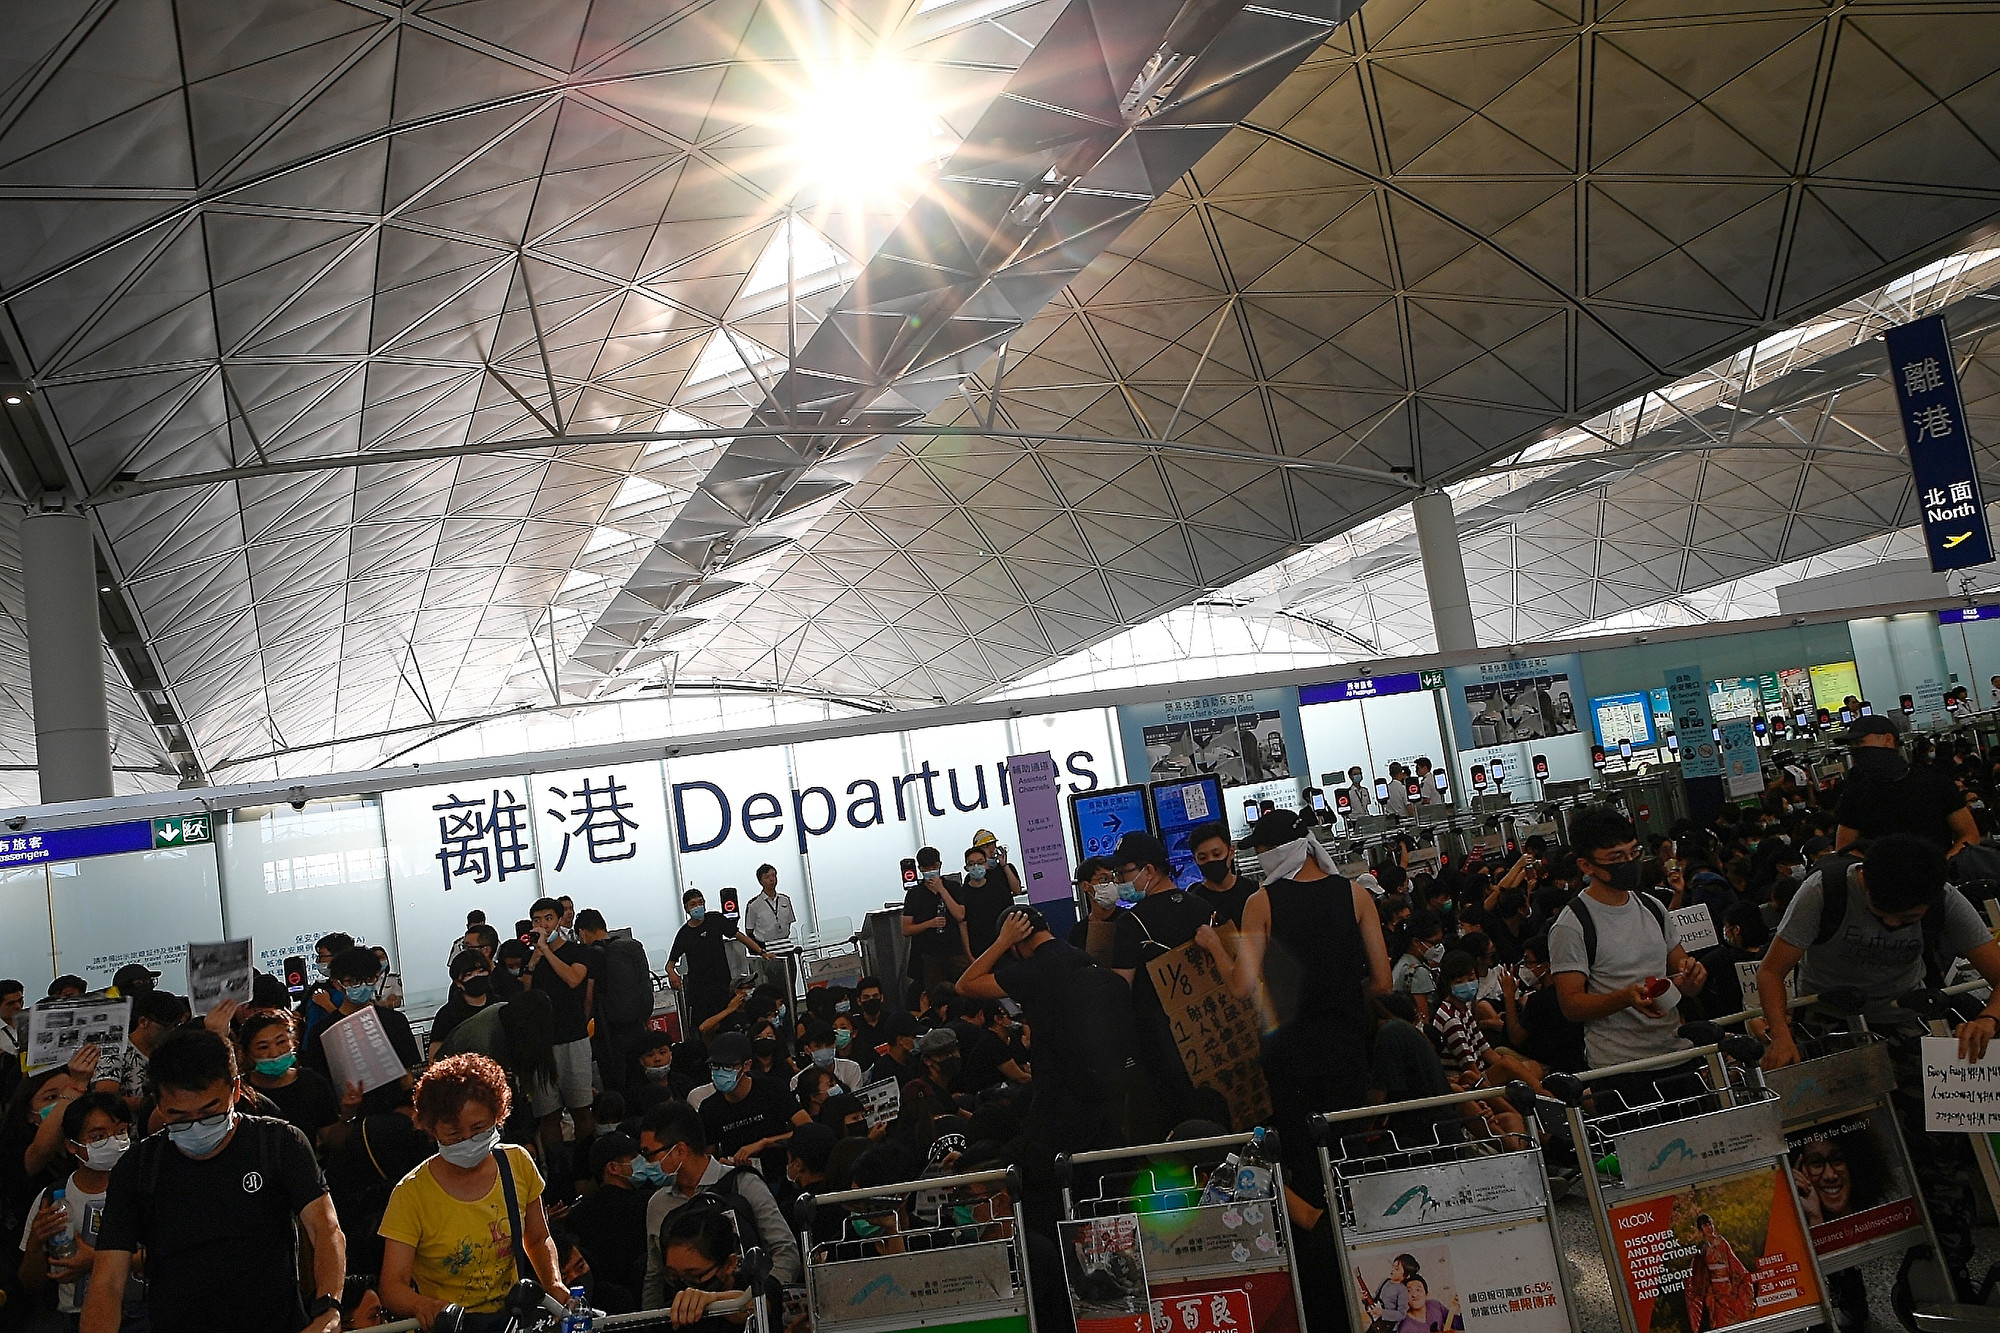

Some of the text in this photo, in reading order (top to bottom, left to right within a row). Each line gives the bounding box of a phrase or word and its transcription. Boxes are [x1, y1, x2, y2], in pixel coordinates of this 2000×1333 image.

[1901, 357, 1953, 443] 離港
[1923, 480, 1973, 509] 北面
[1927, 502, 1976, 523] North
[1167, 712, 1183, 722] Easy
[1018, 775, 1047, 785] Assisted
[1019, 783, 1050, 794] Channels
[672, 751, 1098, 855] Departurs
[432, 775, 640, 891] 離港
[295, 932, 330, 944] 保安告
[1927, 1064, 1947, 1084] Kong
[1949, 1064, 1966, 1082] Hong
[1966, 1066, 1986, 1082] With
[1931, 1085, 1975, 1104] Democracy
[1935, 1111, 1966, 1126] Justice
[1966, 1112, 1986, 1127] With
[1803, 1136, 1813, 1145] an
[1813, 1131, 1828, 1142] Eye
[1828, 1128, 1840, 1138] for
[1840, 1117, 1871, 1134] Quality?
[1617, 1211, 1655, 1230] KLOOK
[1623, 1229, 1675, 1249] DISCOVER
[1813, 1230, 1844, 1247] ssurance
[1627, 1239, 1681, 1259] AND BOOK
[1630, 1244, 1702, 1270] ATTRACTIONS,
[1631, 1263, 1669, 1280] TOURS,
[1633, 1267, 1694, 1290] TRANSPORT
[1638, 1281, 1686, 1301] AND WIFI
[1762, 1292, 1792, 1303] KLOOK.COM
